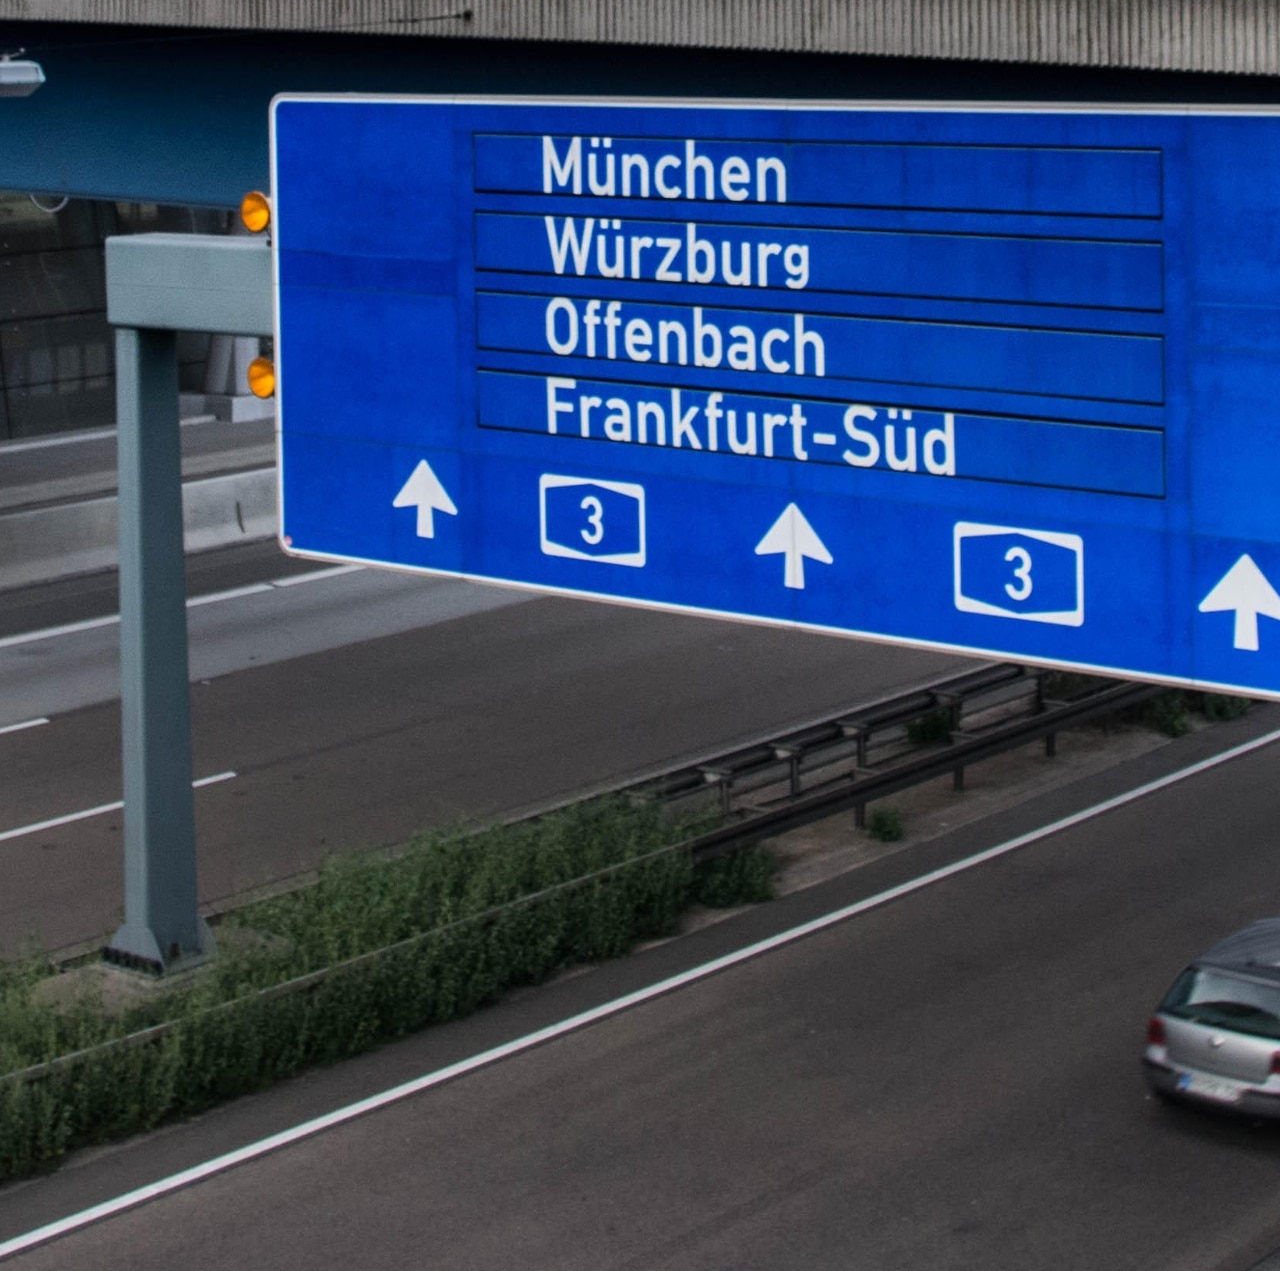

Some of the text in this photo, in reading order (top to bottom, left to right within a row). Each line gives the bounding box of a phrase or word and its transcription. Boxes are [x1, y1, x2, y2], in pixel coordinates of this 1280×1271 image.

[542, 135, 787, 203] München
[545, 215, 810, 290] Würzburg
[545, 297, 825, 377] Offenbach
[545, 377, 956, 477] Frankfurt-Süd
[579, 496, 604, 545] 3
[1004, 546, 1033, 601] 3
